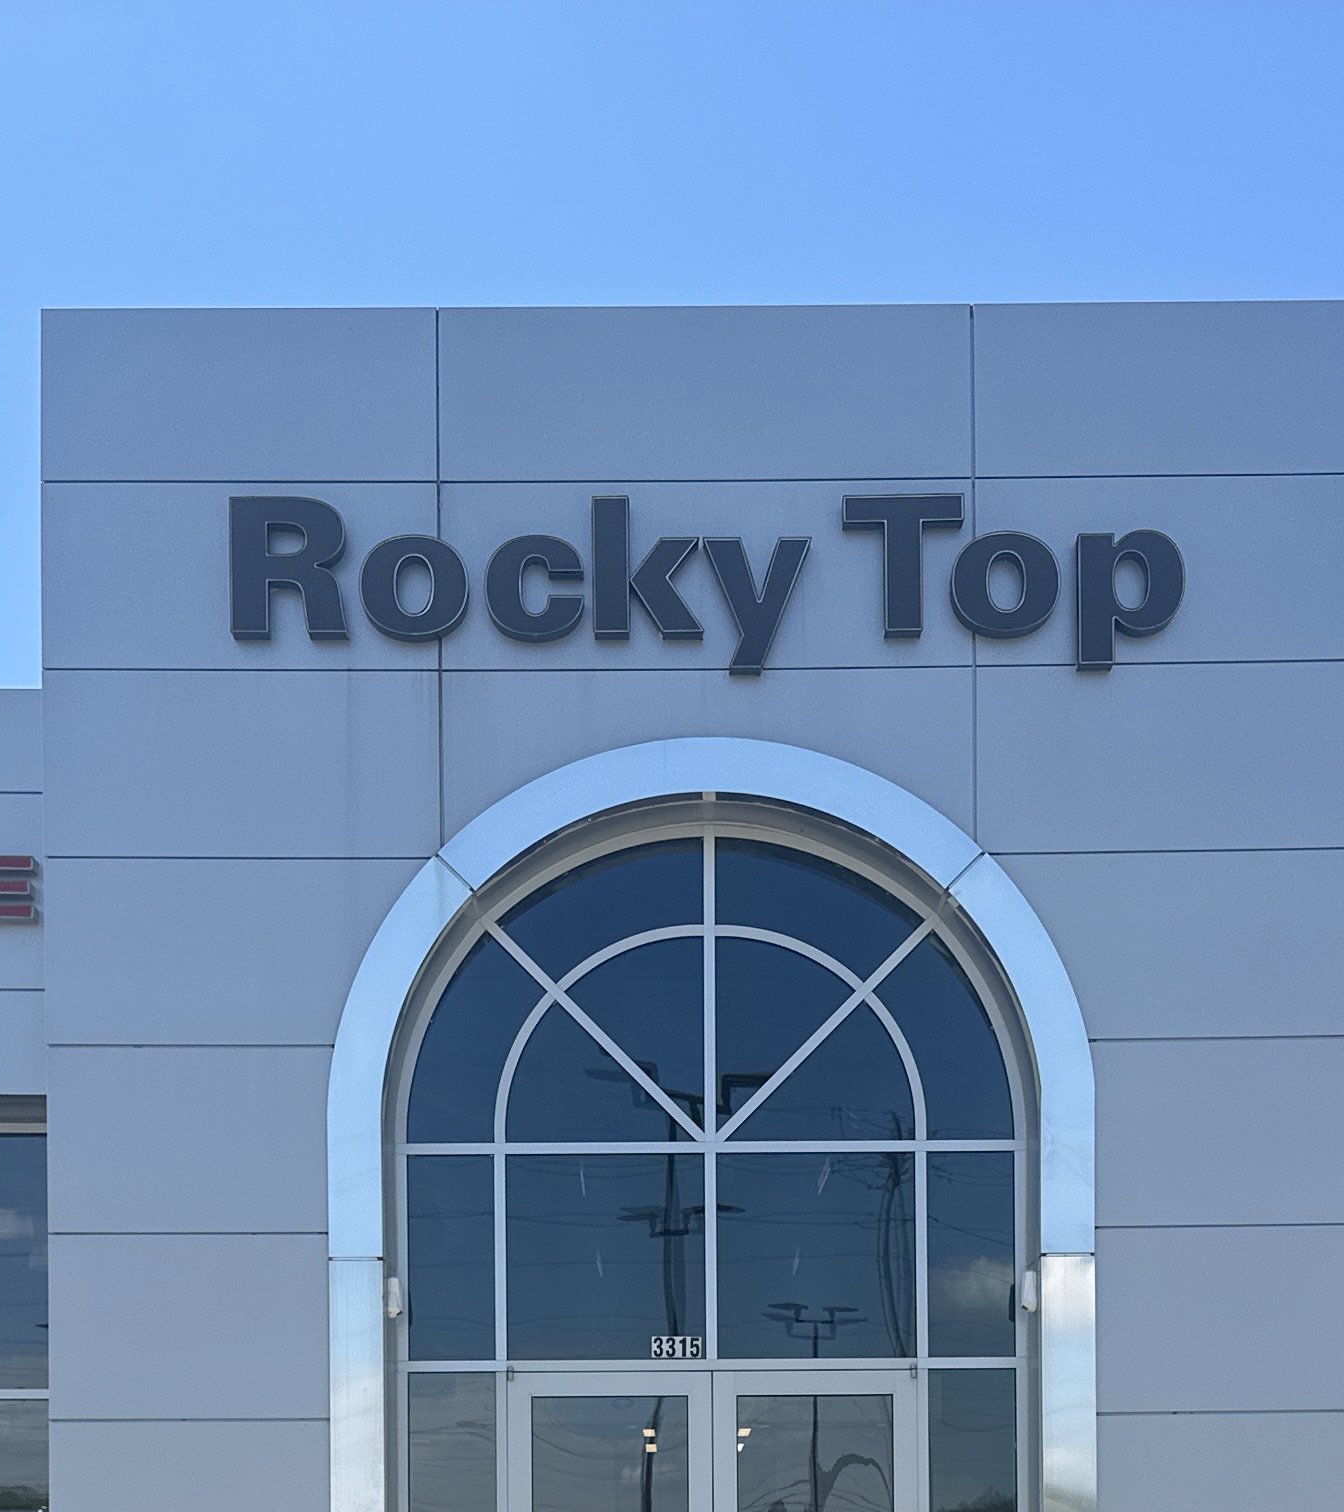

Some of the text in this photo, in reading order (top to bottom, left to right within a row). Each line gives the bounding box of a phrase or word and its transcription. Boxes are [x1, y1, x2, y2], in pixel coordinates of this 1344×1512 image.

[228, 492, 1185, 676] Rocky Top
[653, 1336, 700, 1358] 3315
